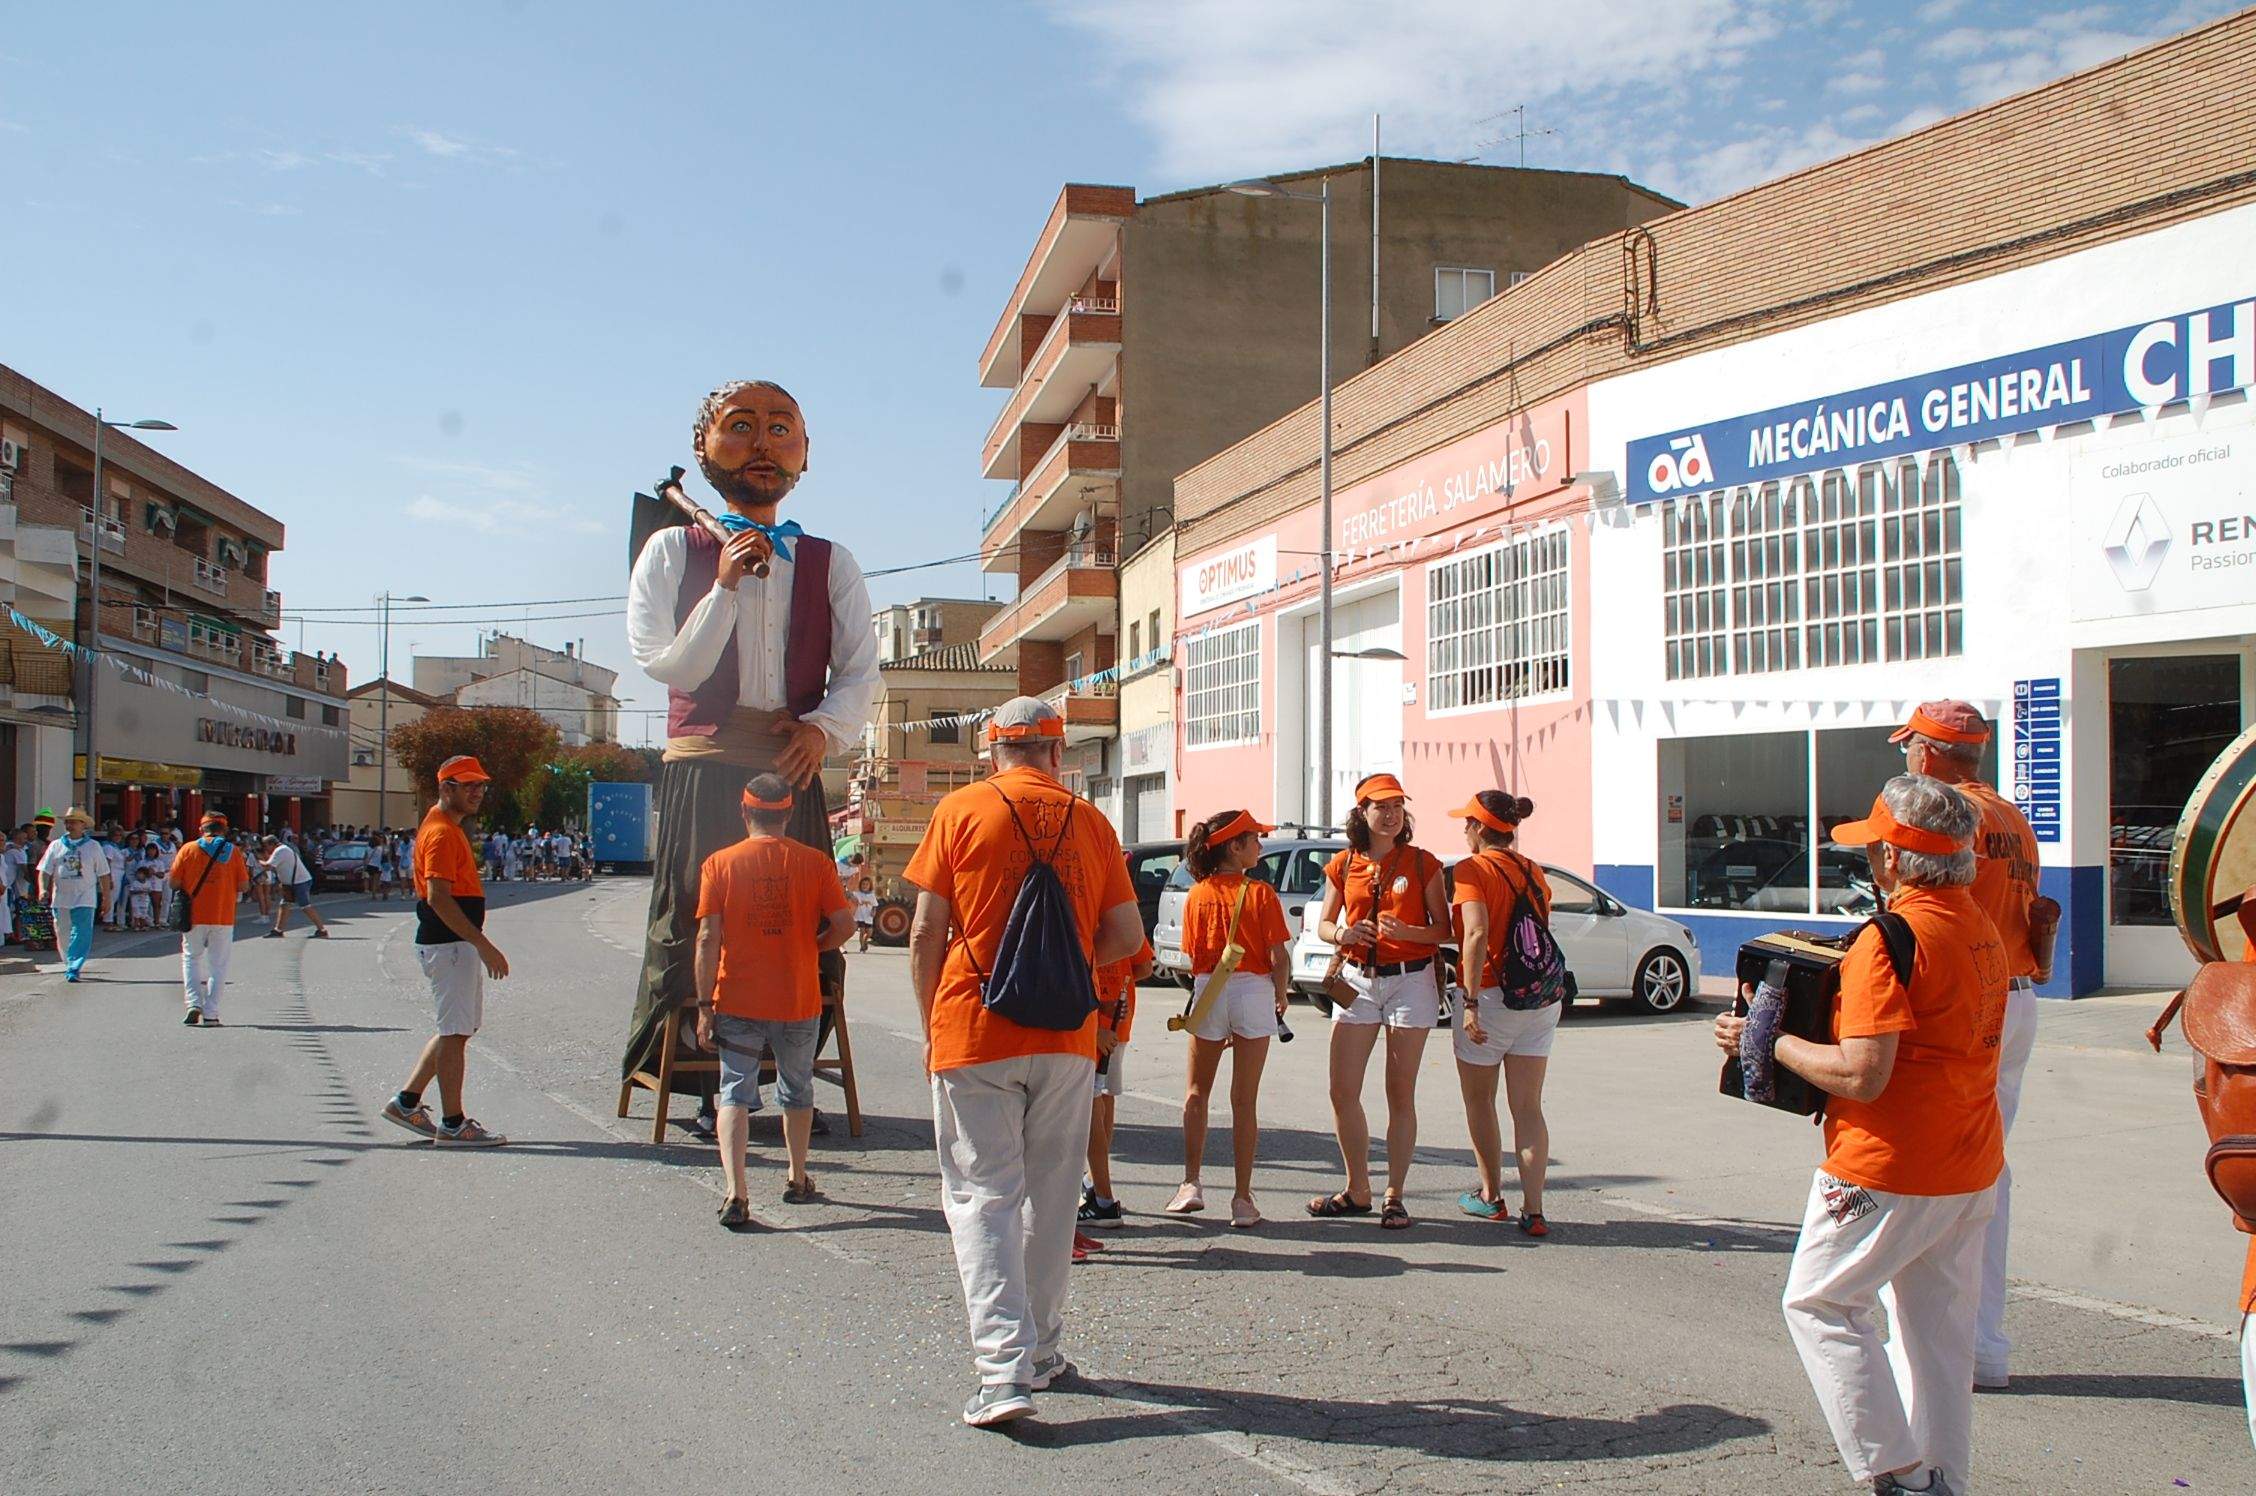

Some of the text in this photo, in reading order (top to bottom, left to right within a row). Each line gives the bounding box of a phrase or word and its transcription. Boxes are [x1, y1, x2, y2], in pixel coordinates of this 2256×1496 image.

[1748, 358, 2091, 468] MECÁNICA GENERAL
[1341, 438, 1551, 547] FERRETERÍA SALAMERO
[2102, 444, 2231, 479] Colaborador oficial
[1199, 549, 1256, 595] OPTIMUS
